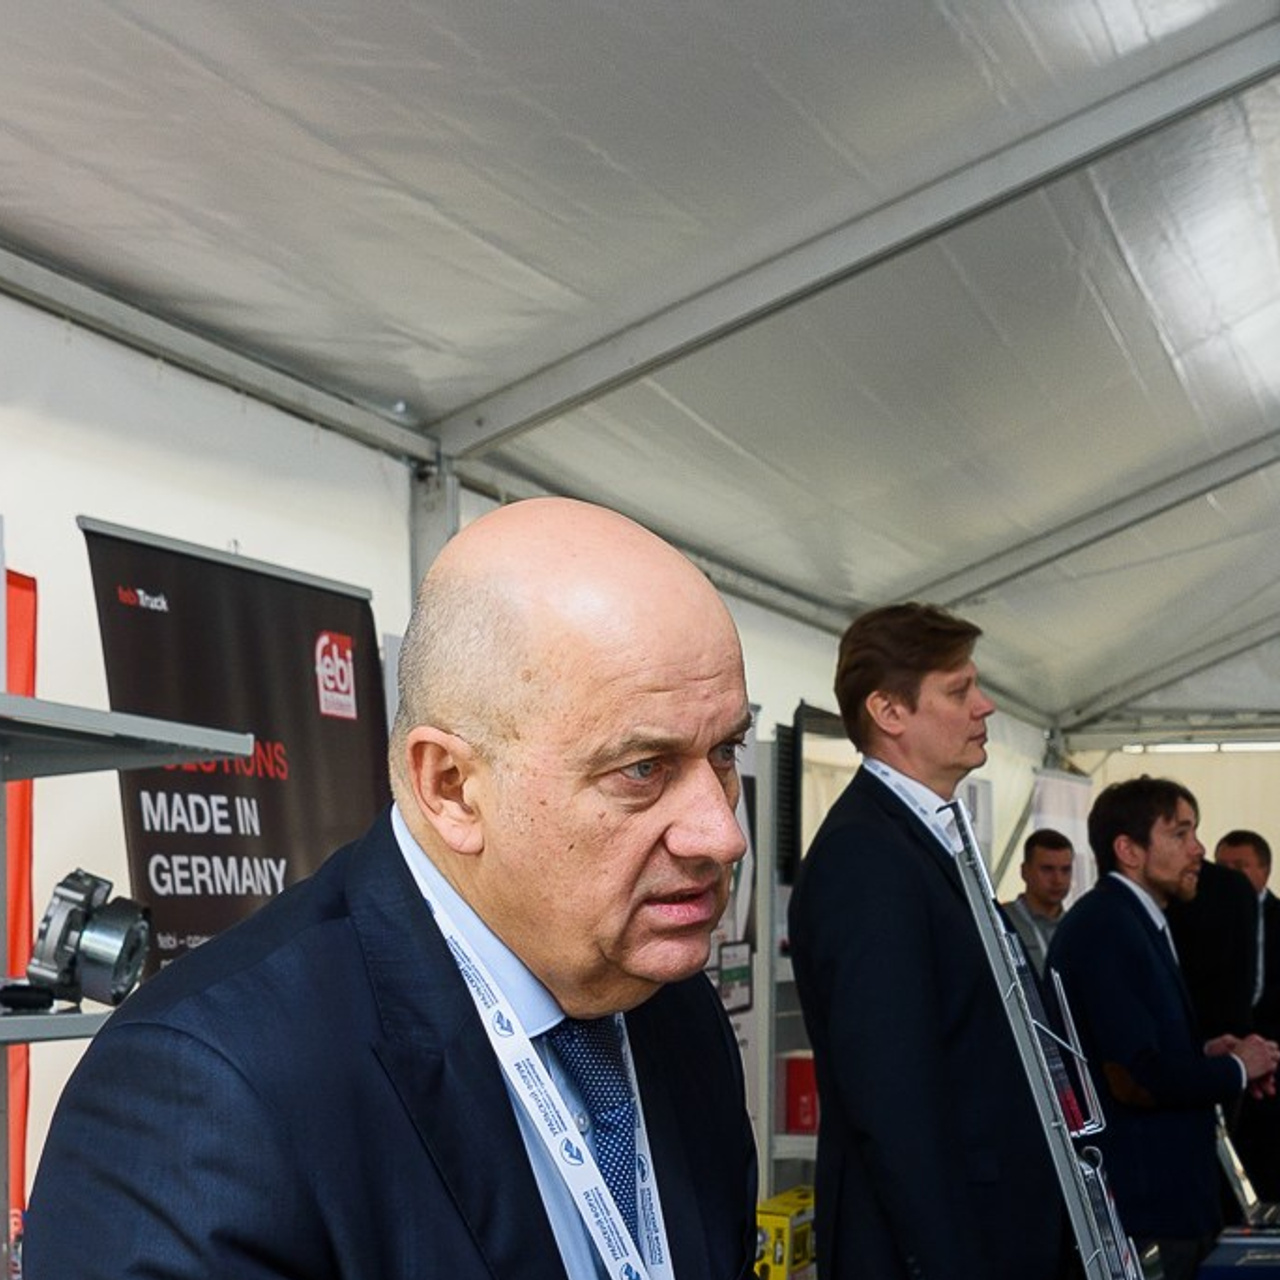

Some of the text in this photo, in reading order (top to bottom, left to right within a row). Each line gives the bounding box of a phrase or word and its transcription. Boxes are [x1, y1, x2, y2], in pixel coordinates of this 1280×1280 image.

[316, 635, 354, 694] febi
[141, 790, 260, 835] MADE IN
[149, 854, 286, 895] GERMANY
